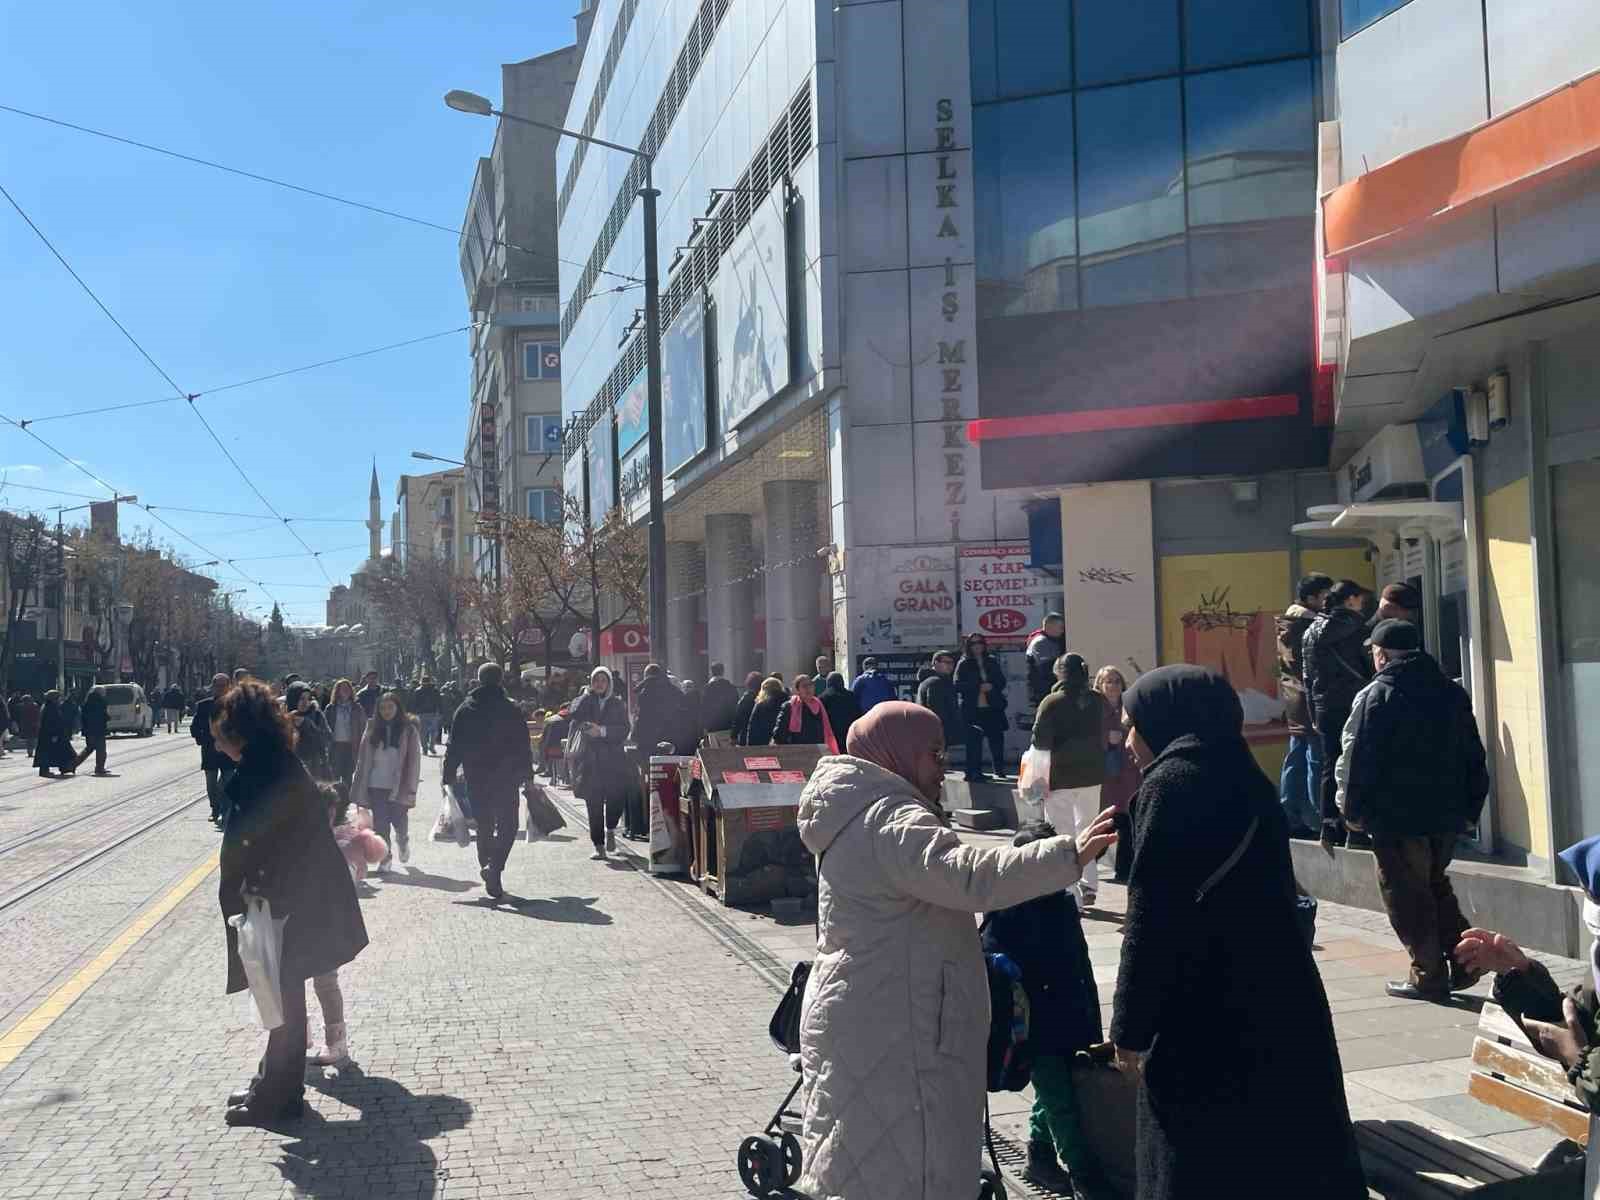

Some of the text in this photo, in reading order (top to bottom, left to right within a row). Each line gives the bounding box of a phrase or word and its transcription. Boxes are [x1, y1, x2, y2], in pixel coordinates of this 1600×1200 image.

[935, 98, 960, 238] SELKA
[937, 339, 967, 541] MERKEZİ
[992, 562, 1024, 575] KAP
[899, 578, 949, 594] GALA
[894, 595, 954, 612] GRAND
[973, 593, 1035, 608] YEMEK
